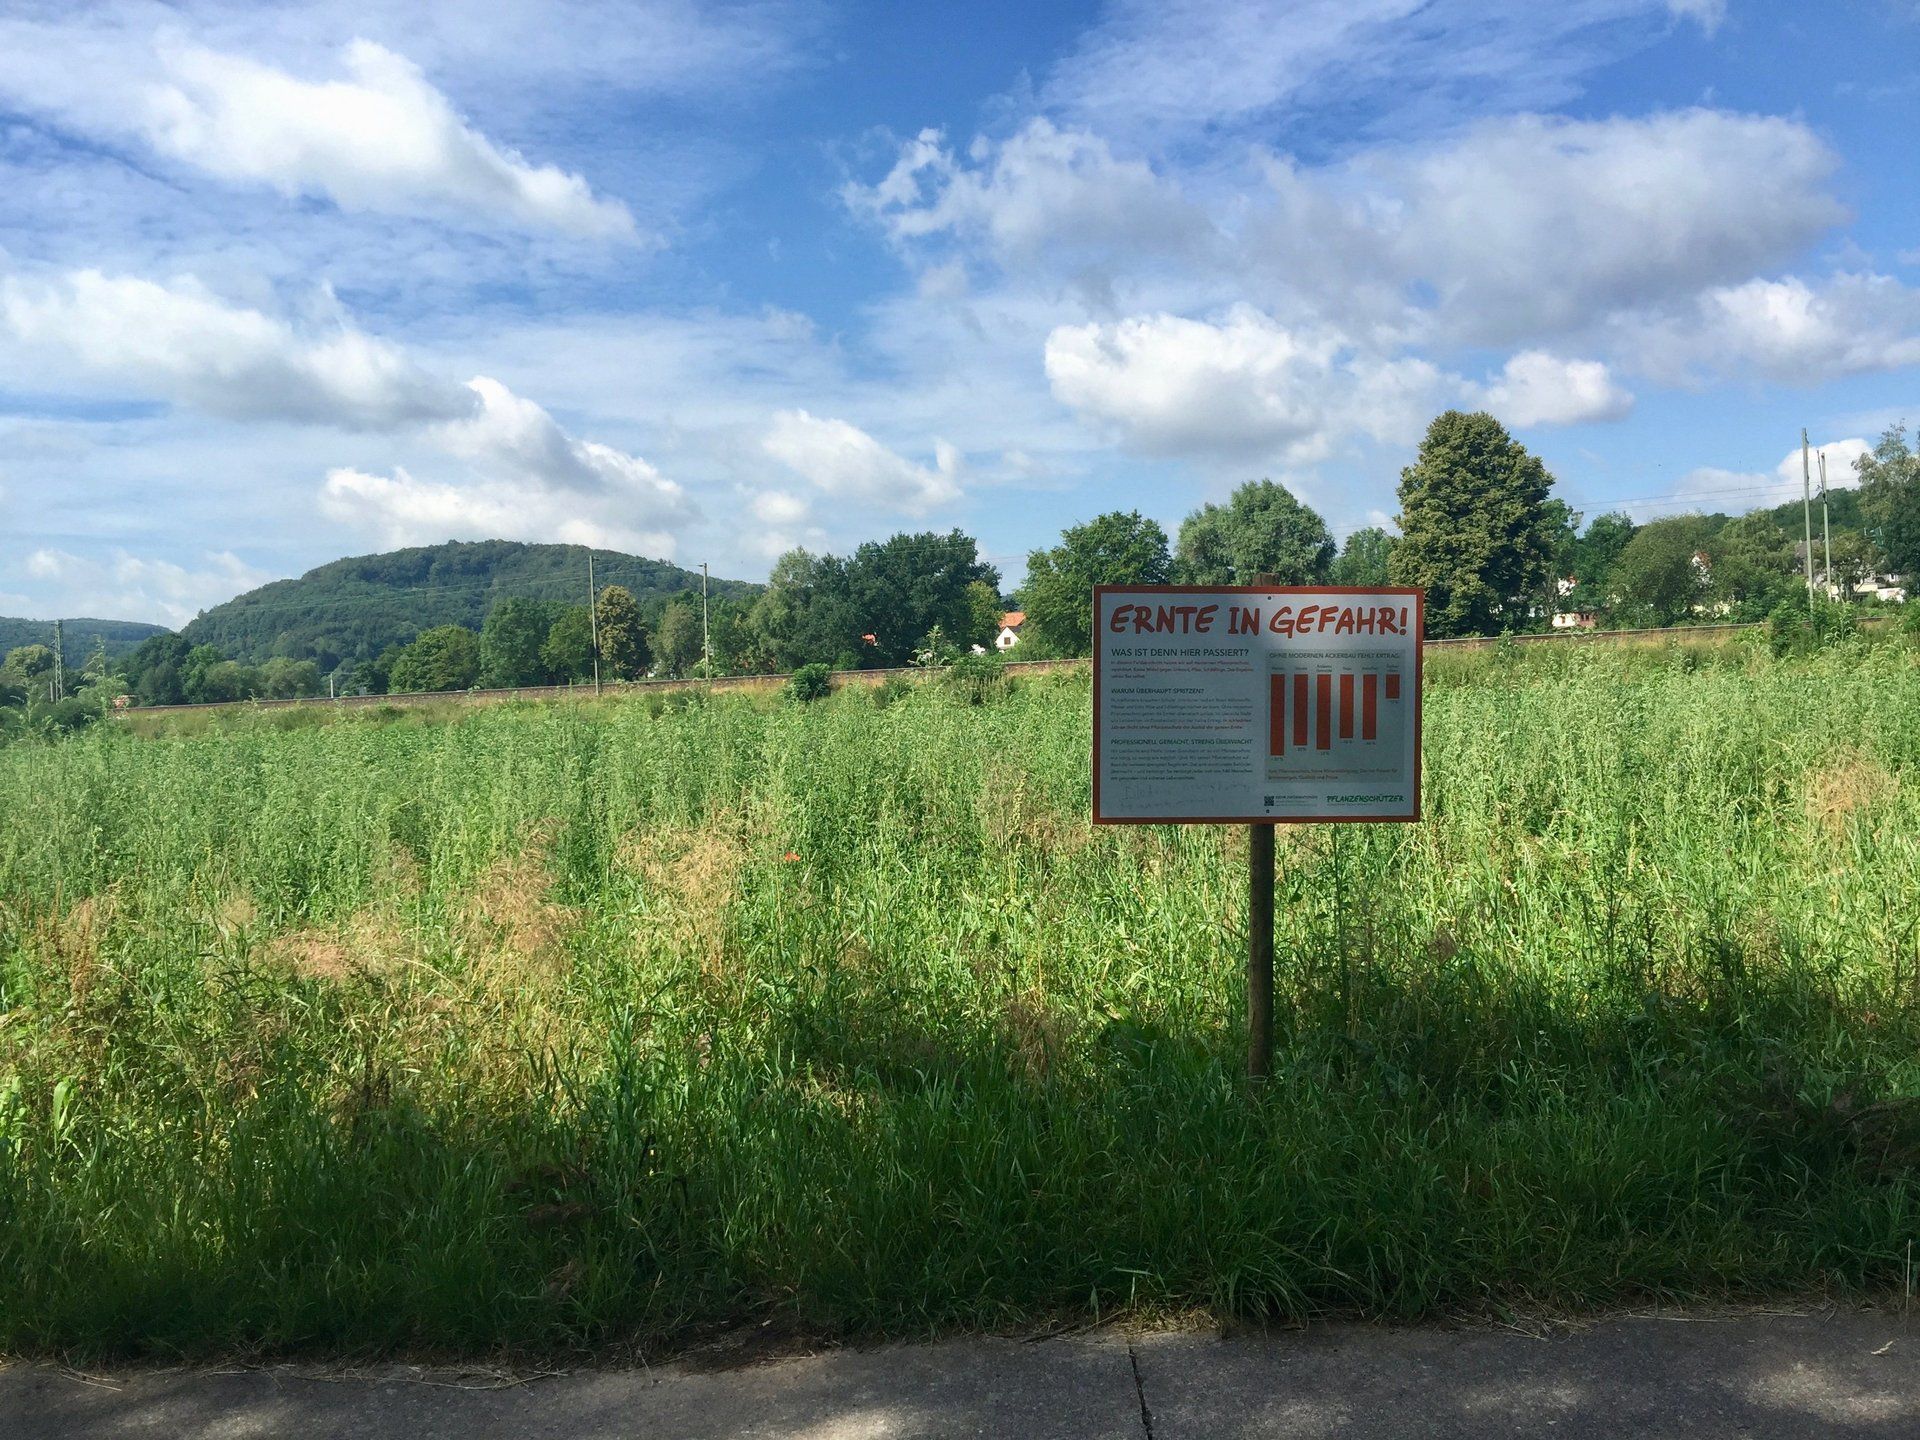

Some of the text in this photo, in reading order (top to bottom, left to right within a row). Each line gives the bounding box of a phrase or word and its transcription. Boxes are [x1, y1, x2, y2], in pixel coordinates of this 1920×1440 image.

[1110, 603, 1408, 639] ERNTE IN GEFAHR!
[1111, 648, 1249, 656] WAS IST DENN HIER PASSIERT?
[1216, 737, 1253, 745] ÜBERWACHT
[1326, 794, 1404, 803] PFLANZENSCHÜTZER
